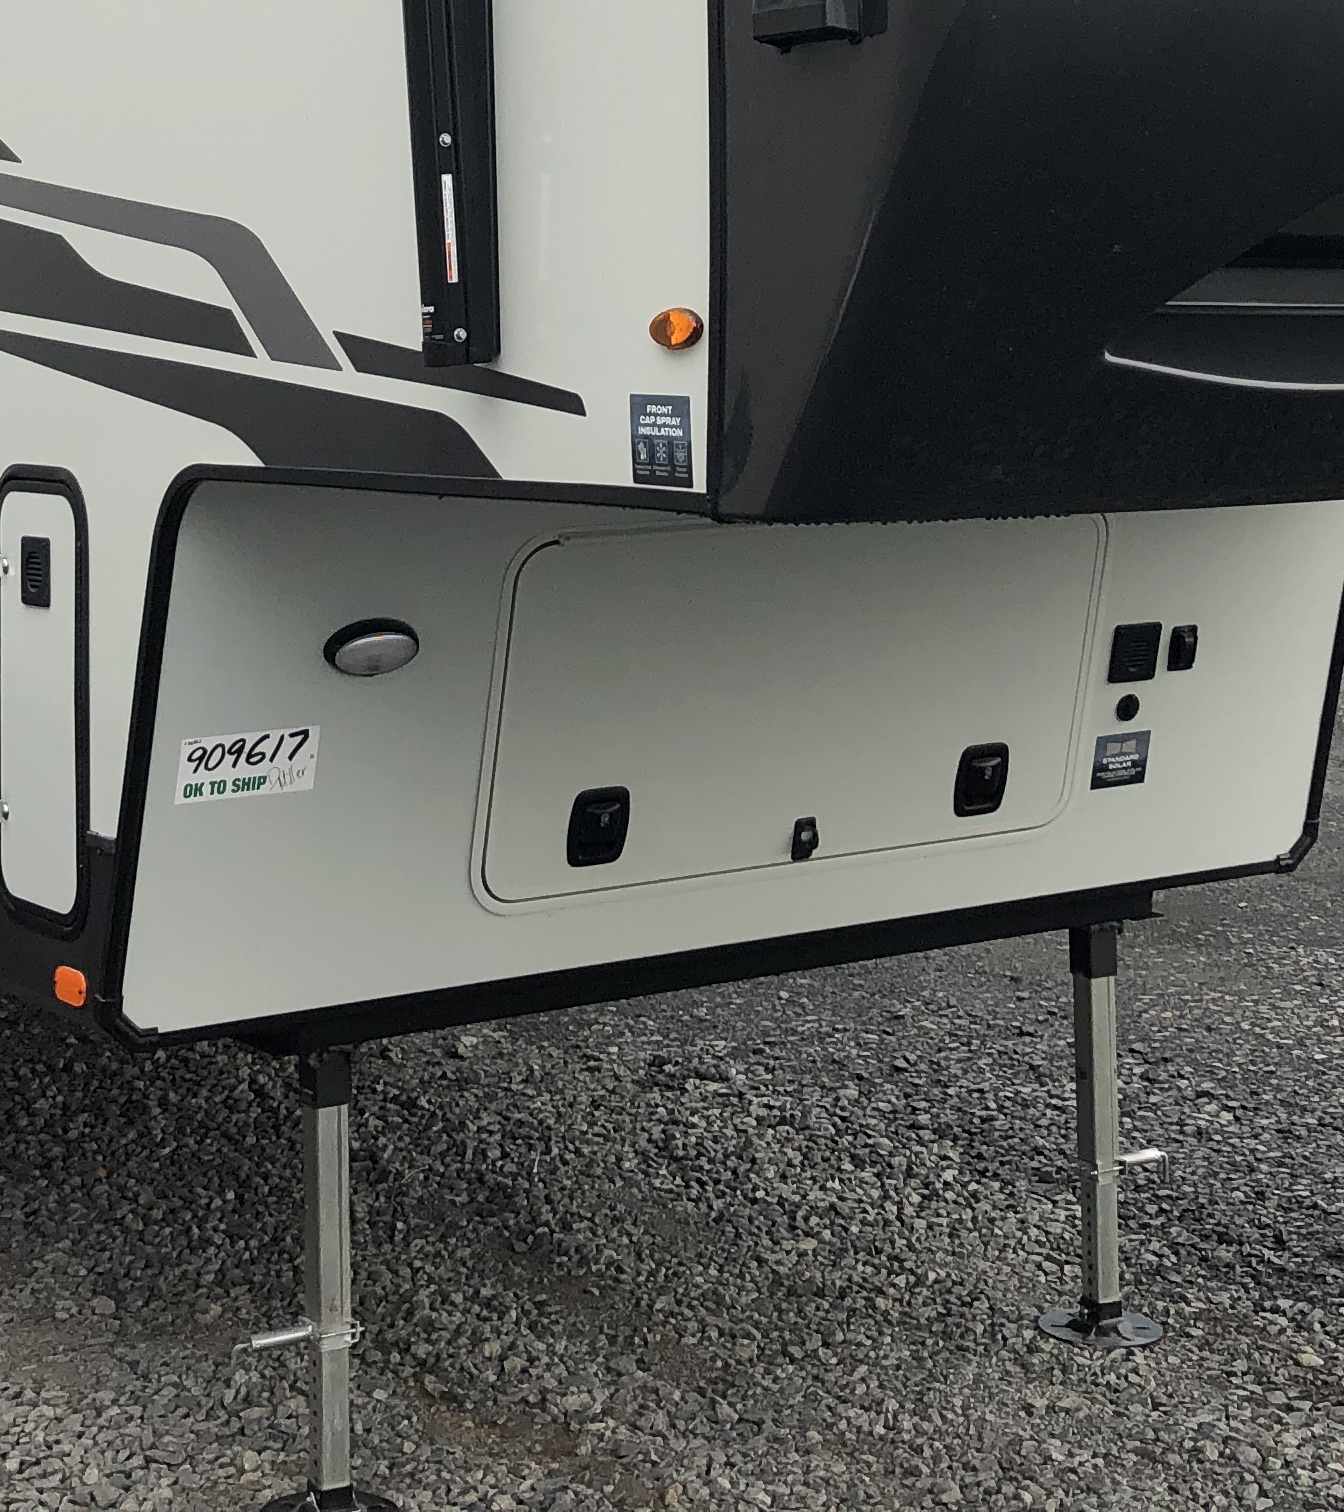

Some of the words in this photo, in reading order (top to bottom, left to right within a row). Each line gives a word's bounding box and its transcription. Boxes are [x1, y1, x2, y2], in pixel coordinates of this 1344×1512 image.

[646, 404, 673, 414] FRONT
[639, 415, 655, 424] CAP
[656, 416, 681, 425] SPRAY
[638, 426, 683, 436] INSULATION
[187, 729, 310, 775] 909617
[1102, 754, 1140, 764] STANDARD
[1108, 761, 1132, 770] SOLAR
[183, 781, 204, 799] OK
[209, 779, 227, 796] TO
[231, 775, 267, 794] SHIP
